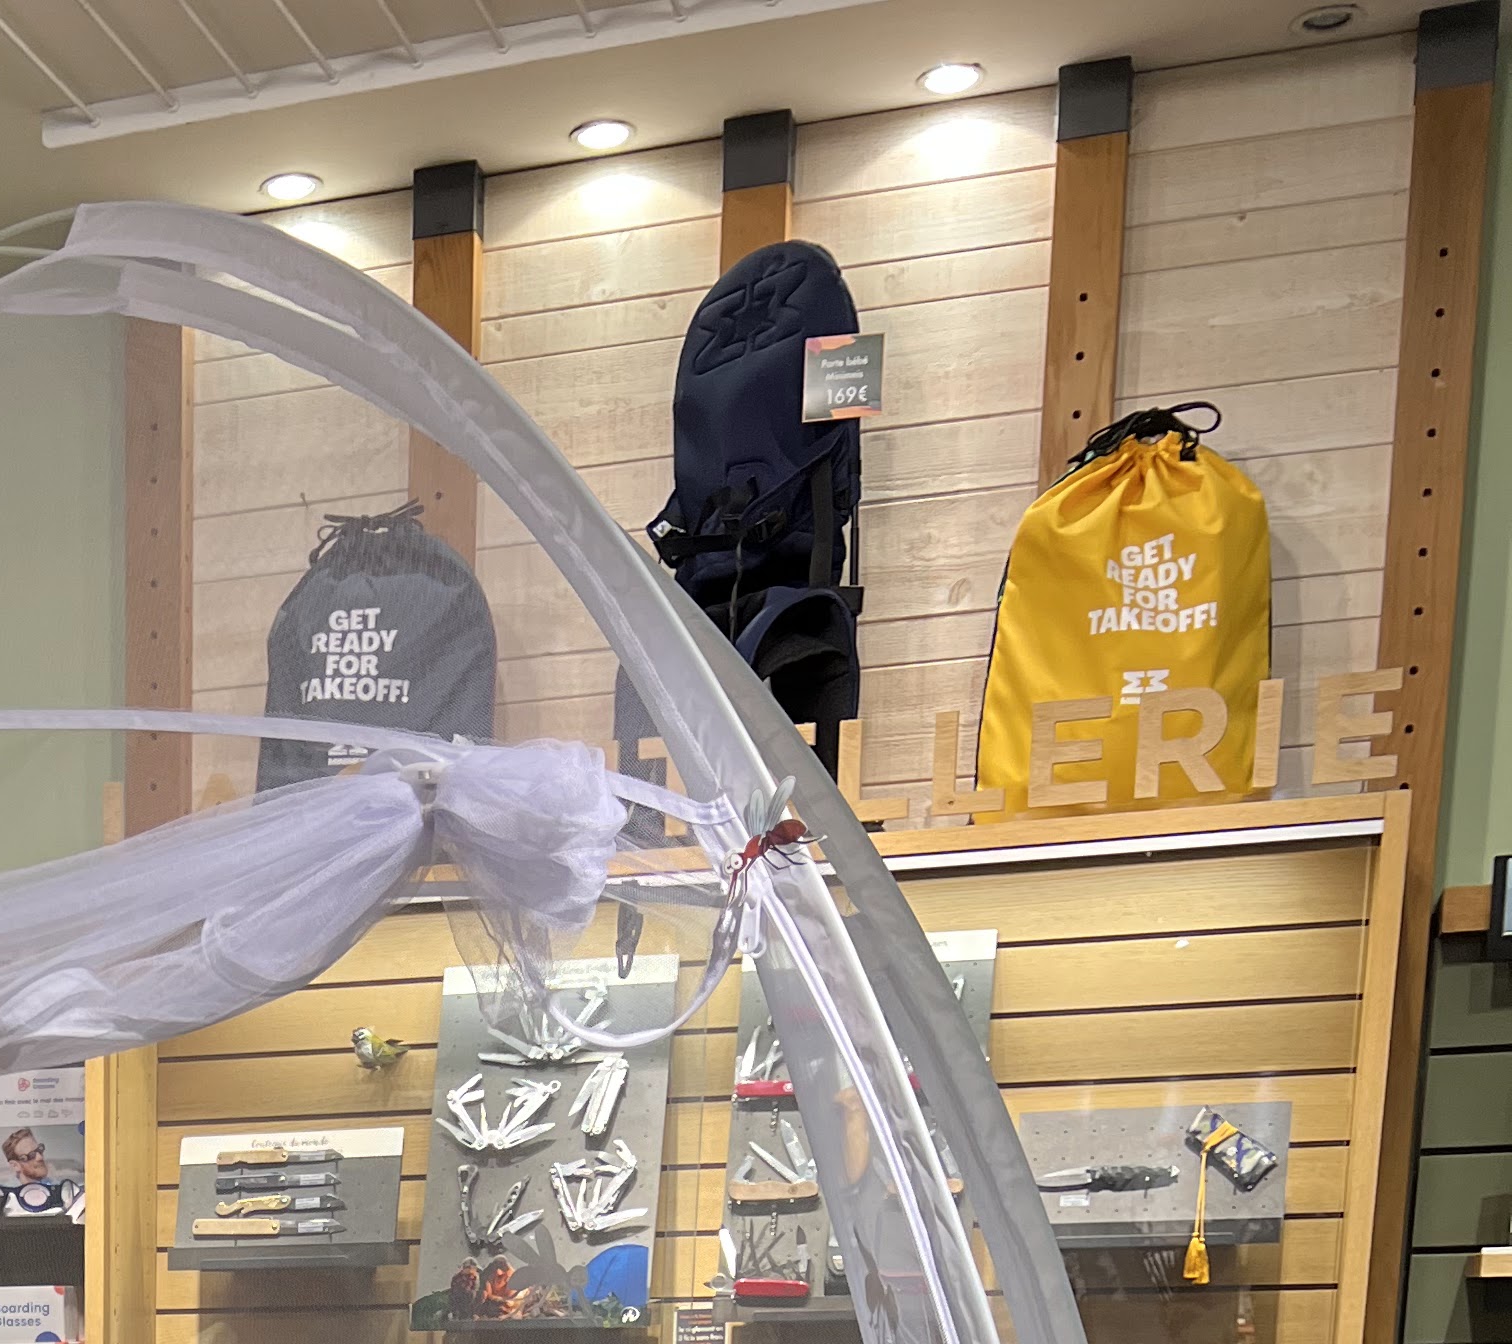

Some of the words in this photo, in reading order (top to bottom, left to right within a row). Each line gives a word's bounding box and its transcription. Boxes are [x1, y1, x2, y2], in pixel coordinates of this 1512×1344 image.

[827, 385, 868, 404] 169€
[1120, 533, 1174, 567] GET
[1106, 553, 1196, 588] READY
[1122, 588, 1178, 610] FOR
[328, 608, 380, 631] GET
[1088, 601, 1217, 635] TAKEOFF!
[311, 628, 398, 654] READY
[325, 655, 378, 677] FOR
[300, 677, 410, 704] TAKEOFF!
